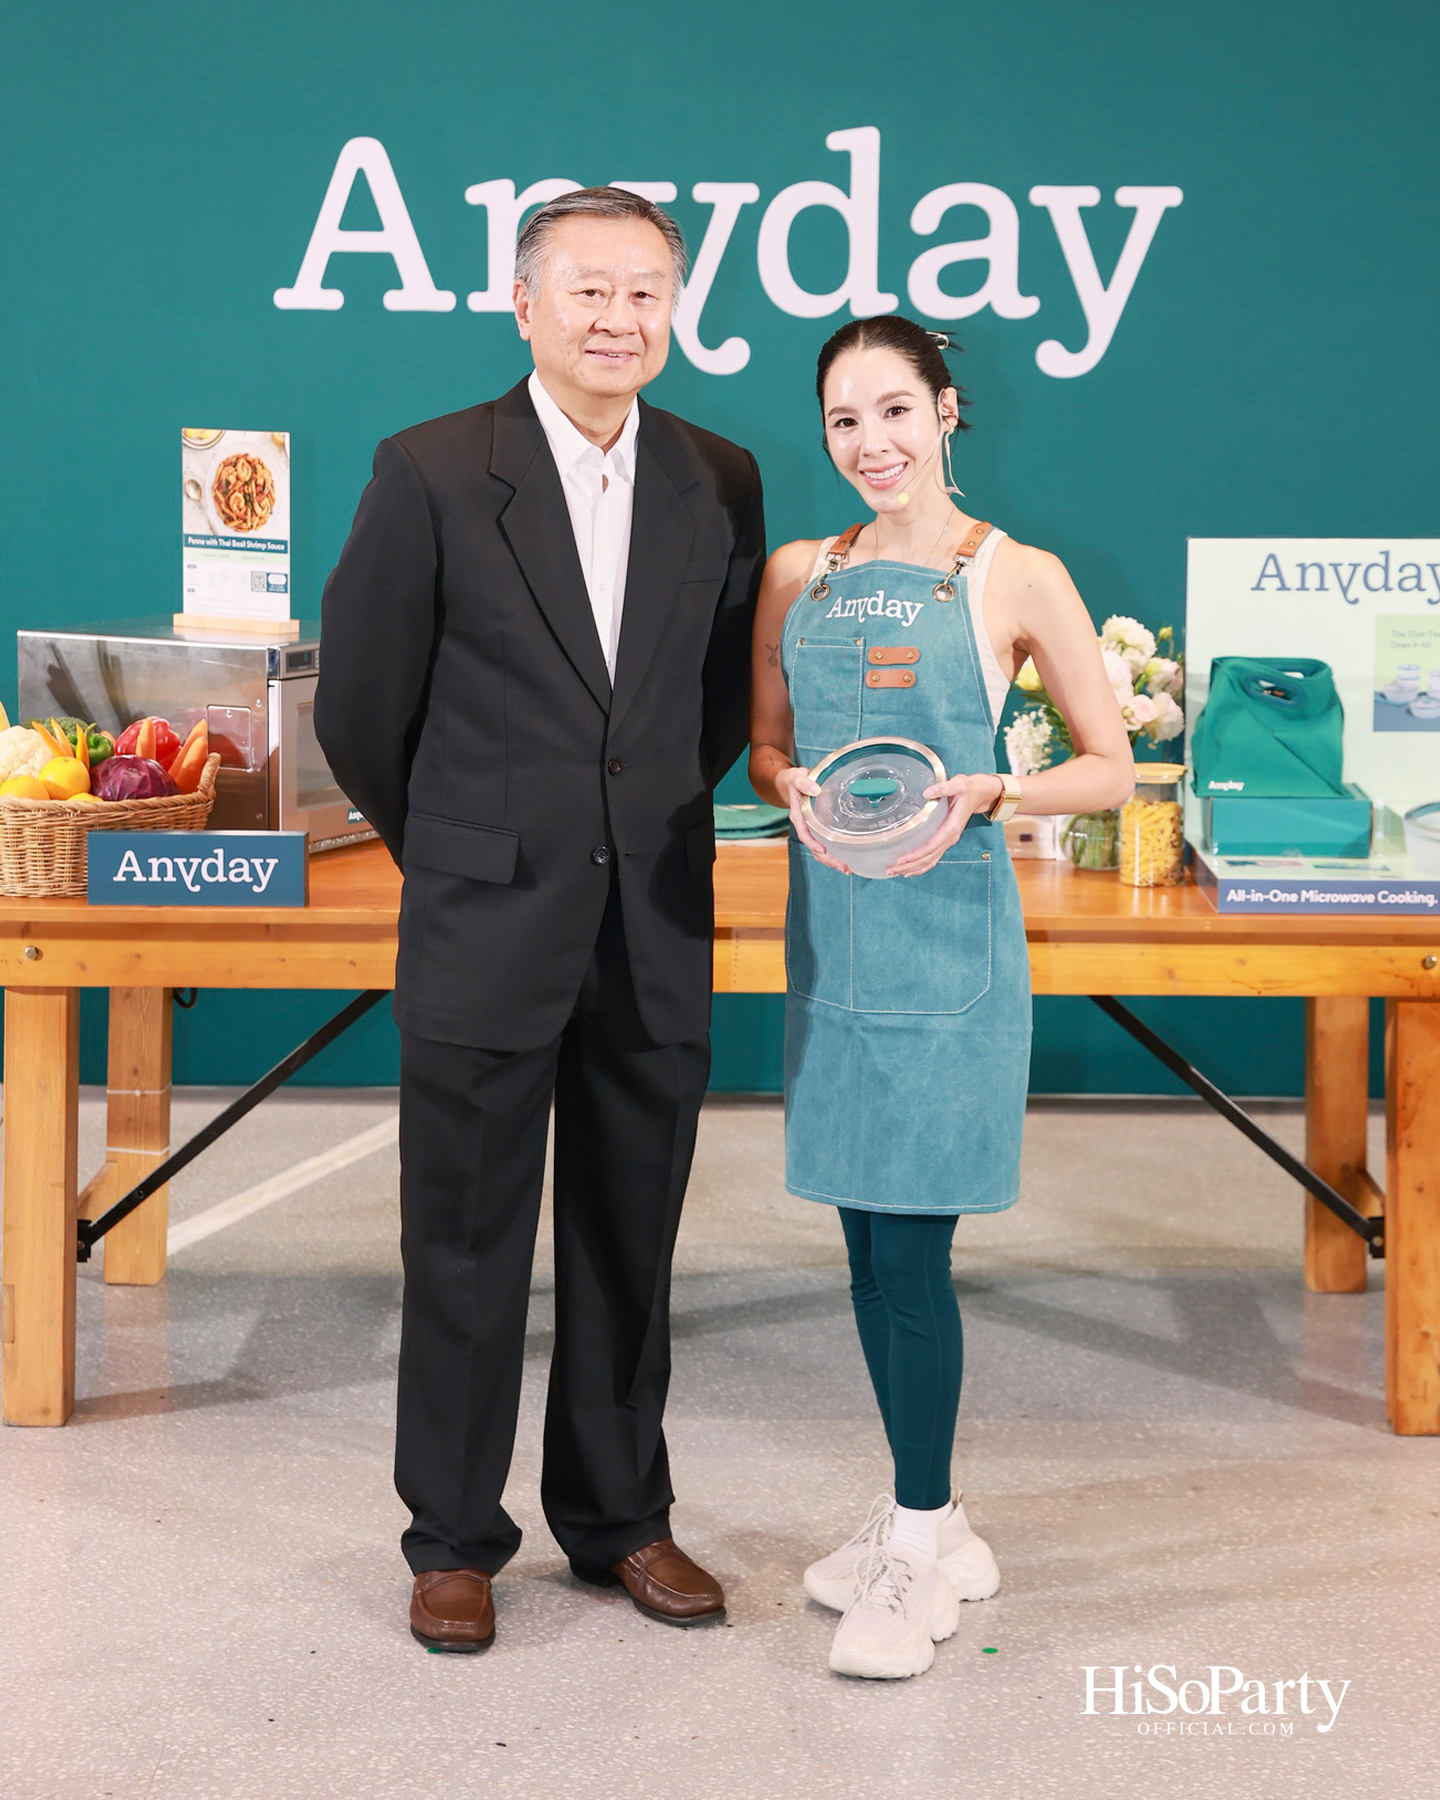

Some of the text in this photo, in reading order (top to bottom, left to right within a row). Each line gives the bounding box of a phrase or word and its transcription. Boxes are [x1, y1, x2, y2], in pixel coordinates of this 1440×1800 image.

[273, 126, 1183, 378] Anyday
[206, 537, 218, 546] with
[218, 538, 231, 547] Thai
[232, 539, 246, 548] Basil
[246, 539, 266, 550] Shrimp
[267, 541, 285, 551] Sauce
[825, 589, 925, 627] Anyday
[1208, 780, 1245, 791] Anyday
[112, 848, 279, 893] Anyday
[1226, 888, 1439, 907] All-in-One Microwave Cooking.
